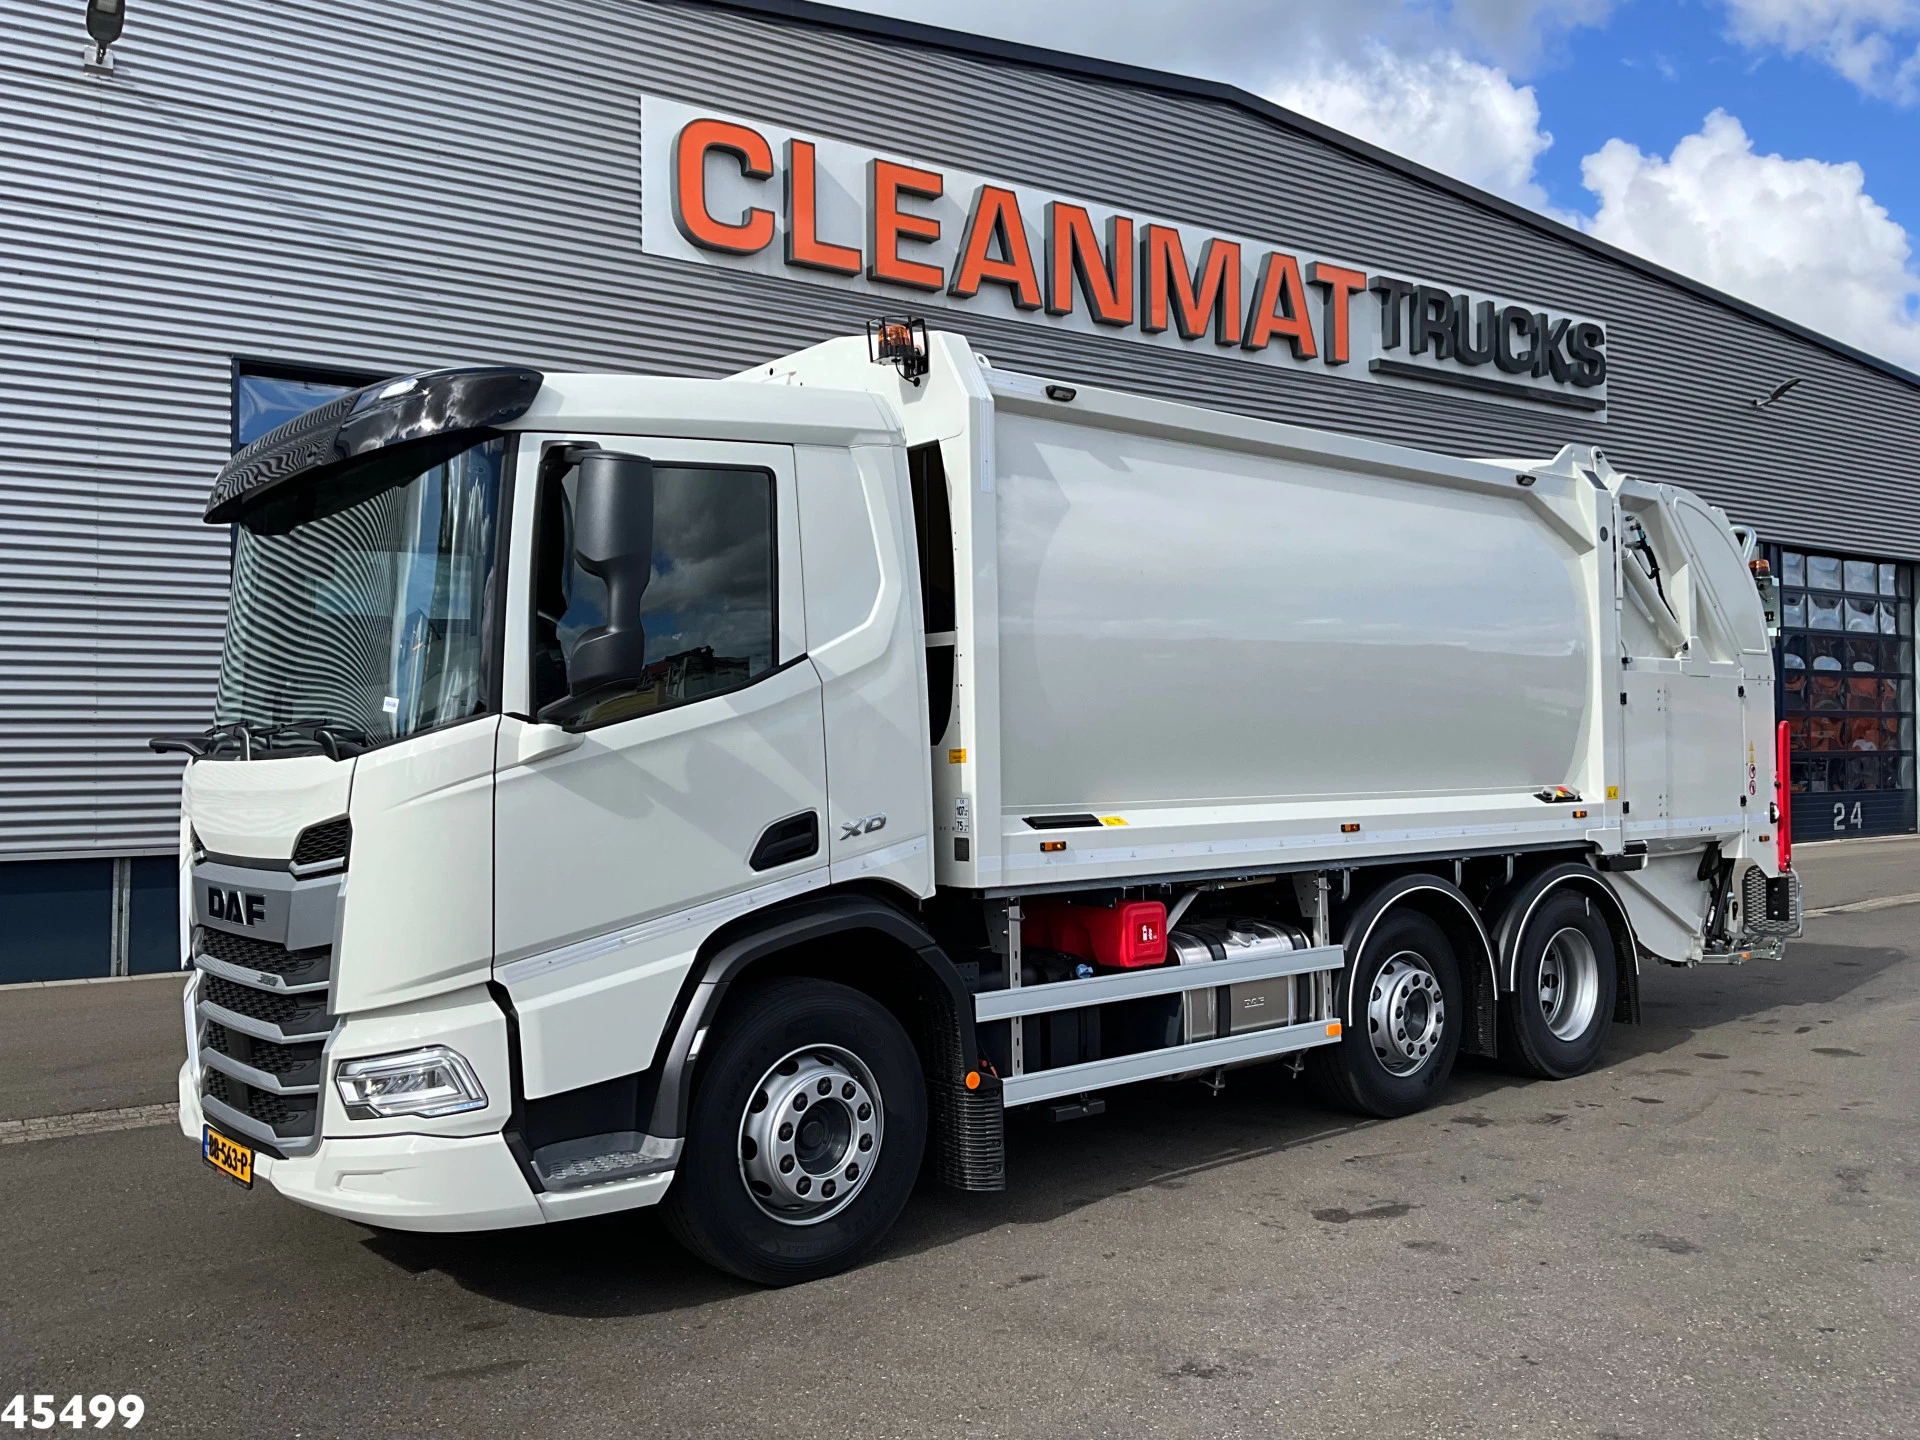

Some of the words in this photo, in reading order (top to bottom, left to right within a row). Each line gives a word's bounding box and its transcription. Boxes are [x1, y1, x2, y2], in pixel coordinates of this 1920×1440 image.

[674, 118, 1367, 365] CLEANMAT
[1369, 276, 1607, 387] TRUCKS
[839, 812, 886, 841] XD
[1833, 801, 1863, 830] 24
[208, 886, 266, 927] DAF
